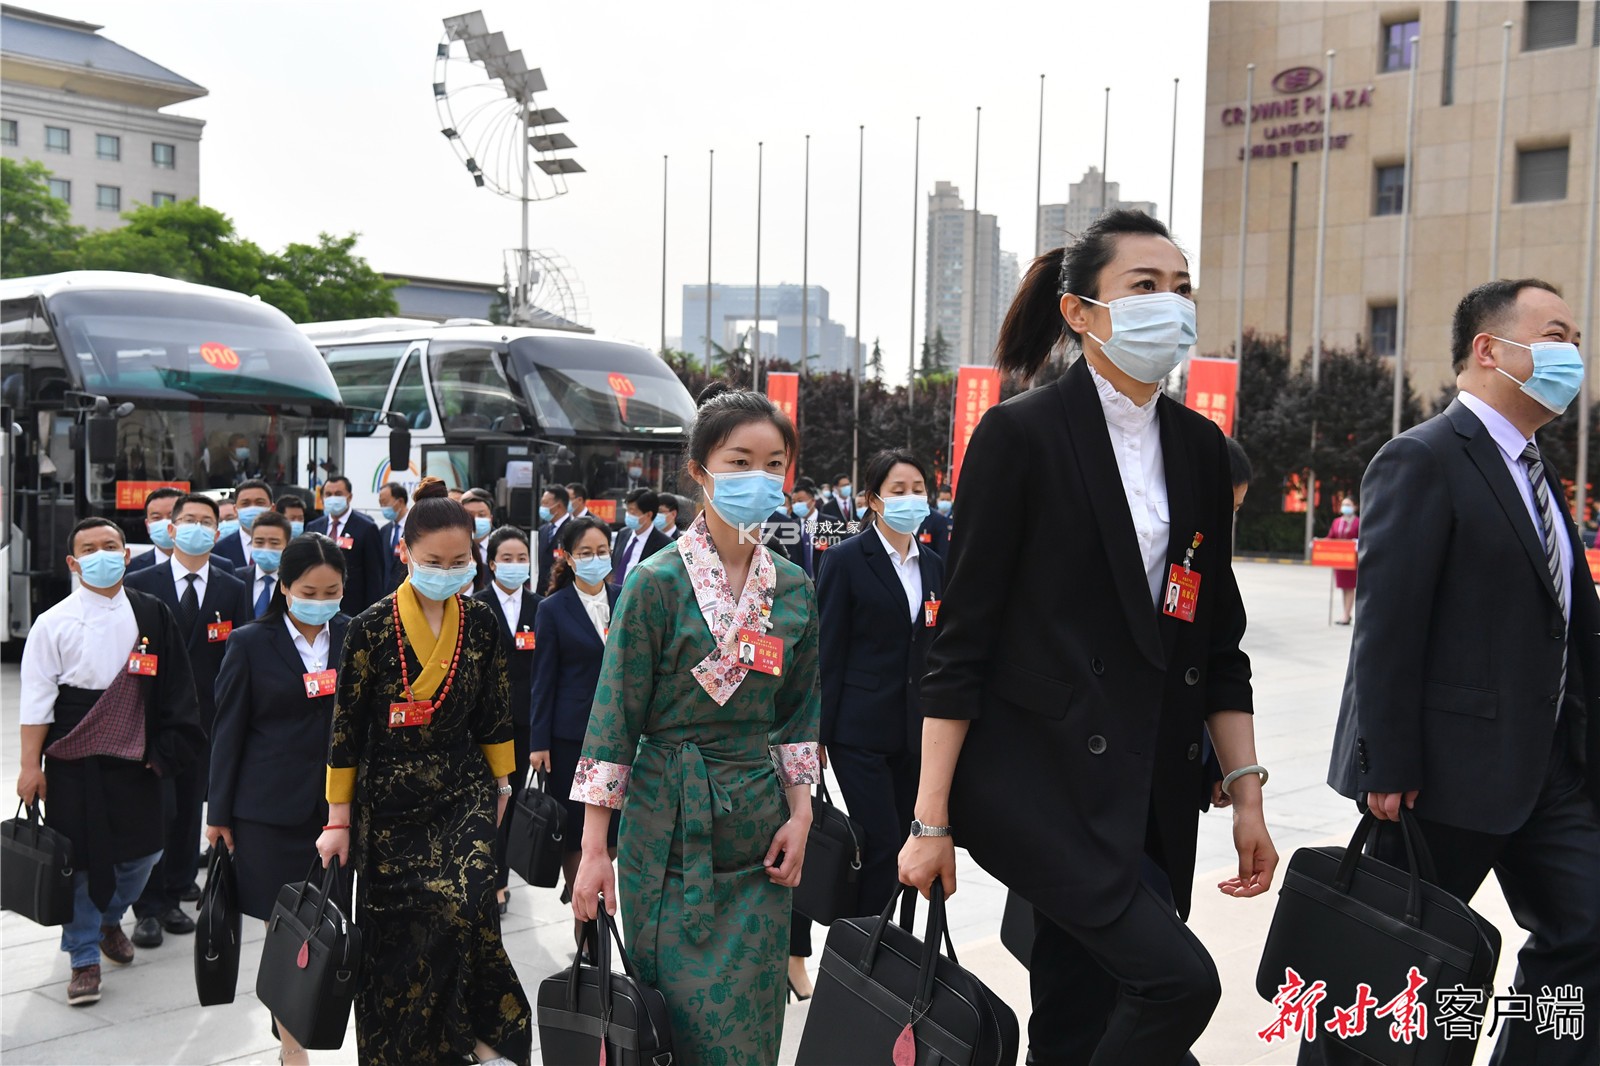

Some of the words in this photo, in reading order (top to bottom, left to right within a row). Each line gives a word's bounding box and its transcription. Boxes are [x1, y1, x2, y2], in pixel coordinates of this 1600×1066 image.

[1304, 89, 1373, 114] PLAZA
[201, 347, 238, 365] 010
[609, 376, 636, 393] 011
